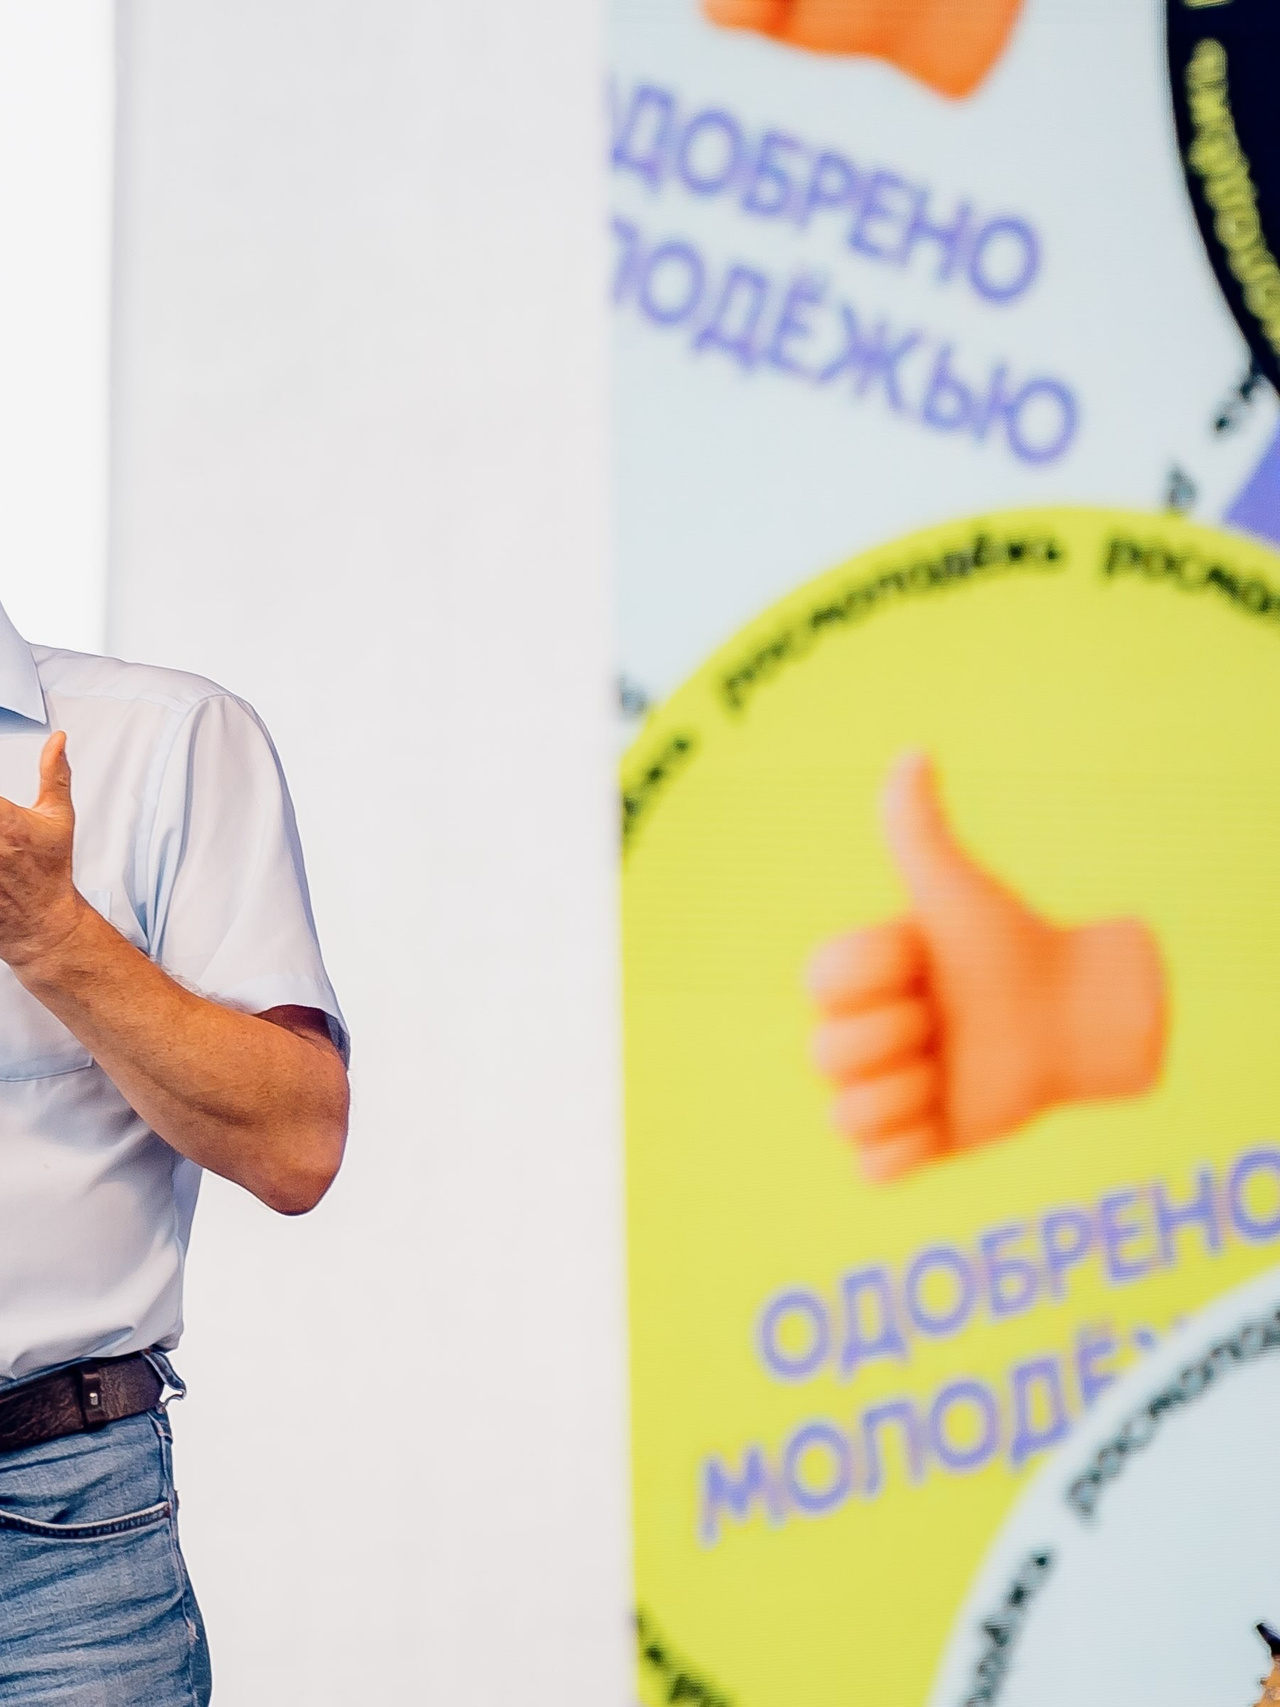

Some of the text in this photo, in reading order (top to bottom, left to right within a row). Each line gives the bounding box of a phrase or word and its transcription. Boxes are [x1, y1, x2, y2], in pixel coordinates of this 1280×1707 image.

[607, 76, 1044, 305] ДОБРЕНО
[756, 1146, 1280, 1383] ОДОБРЕНО
[698, 1320, 1190, 1550] МОЛОДЁ
